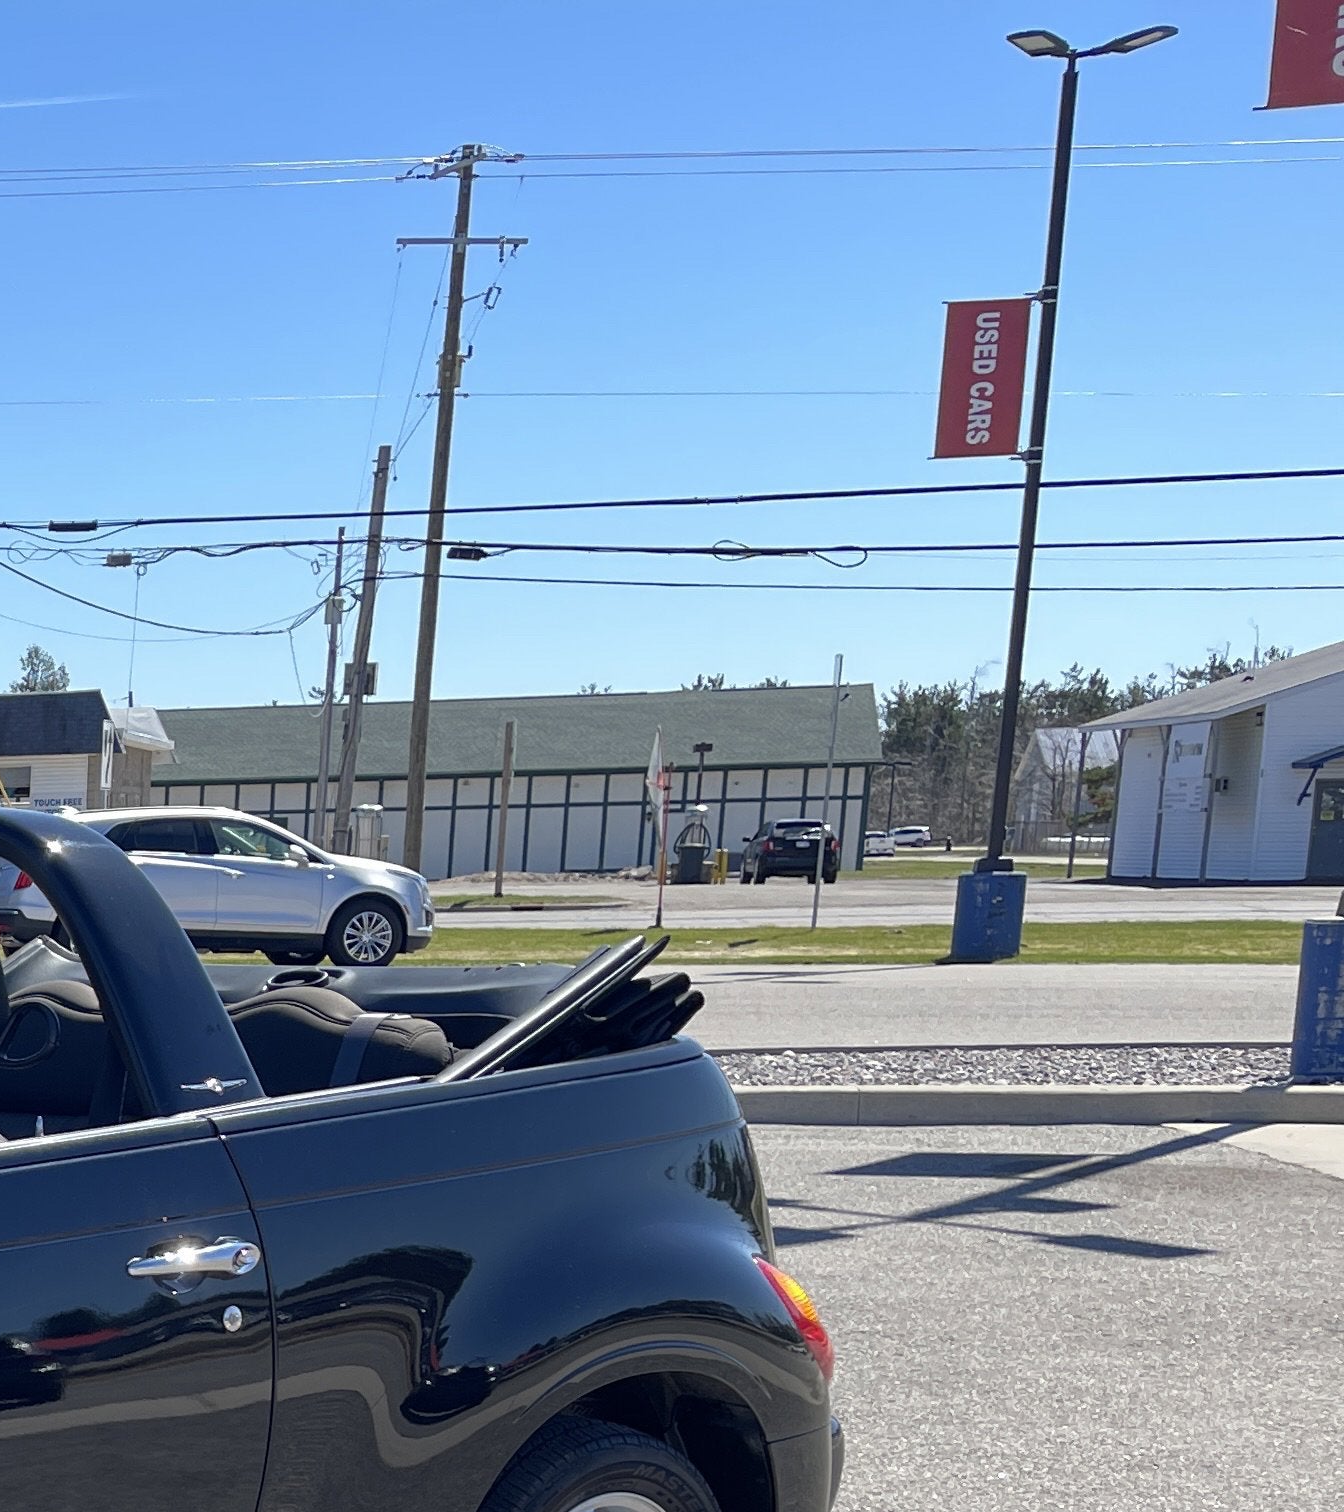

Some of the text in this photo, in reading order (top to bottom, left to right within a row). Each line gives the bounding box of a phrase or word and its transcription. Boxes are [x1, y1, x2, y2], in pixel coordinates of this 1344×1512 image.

[965, 311, 1001, 446] USED CARS
[33, 797, 83, 807] TOUCH FREE
